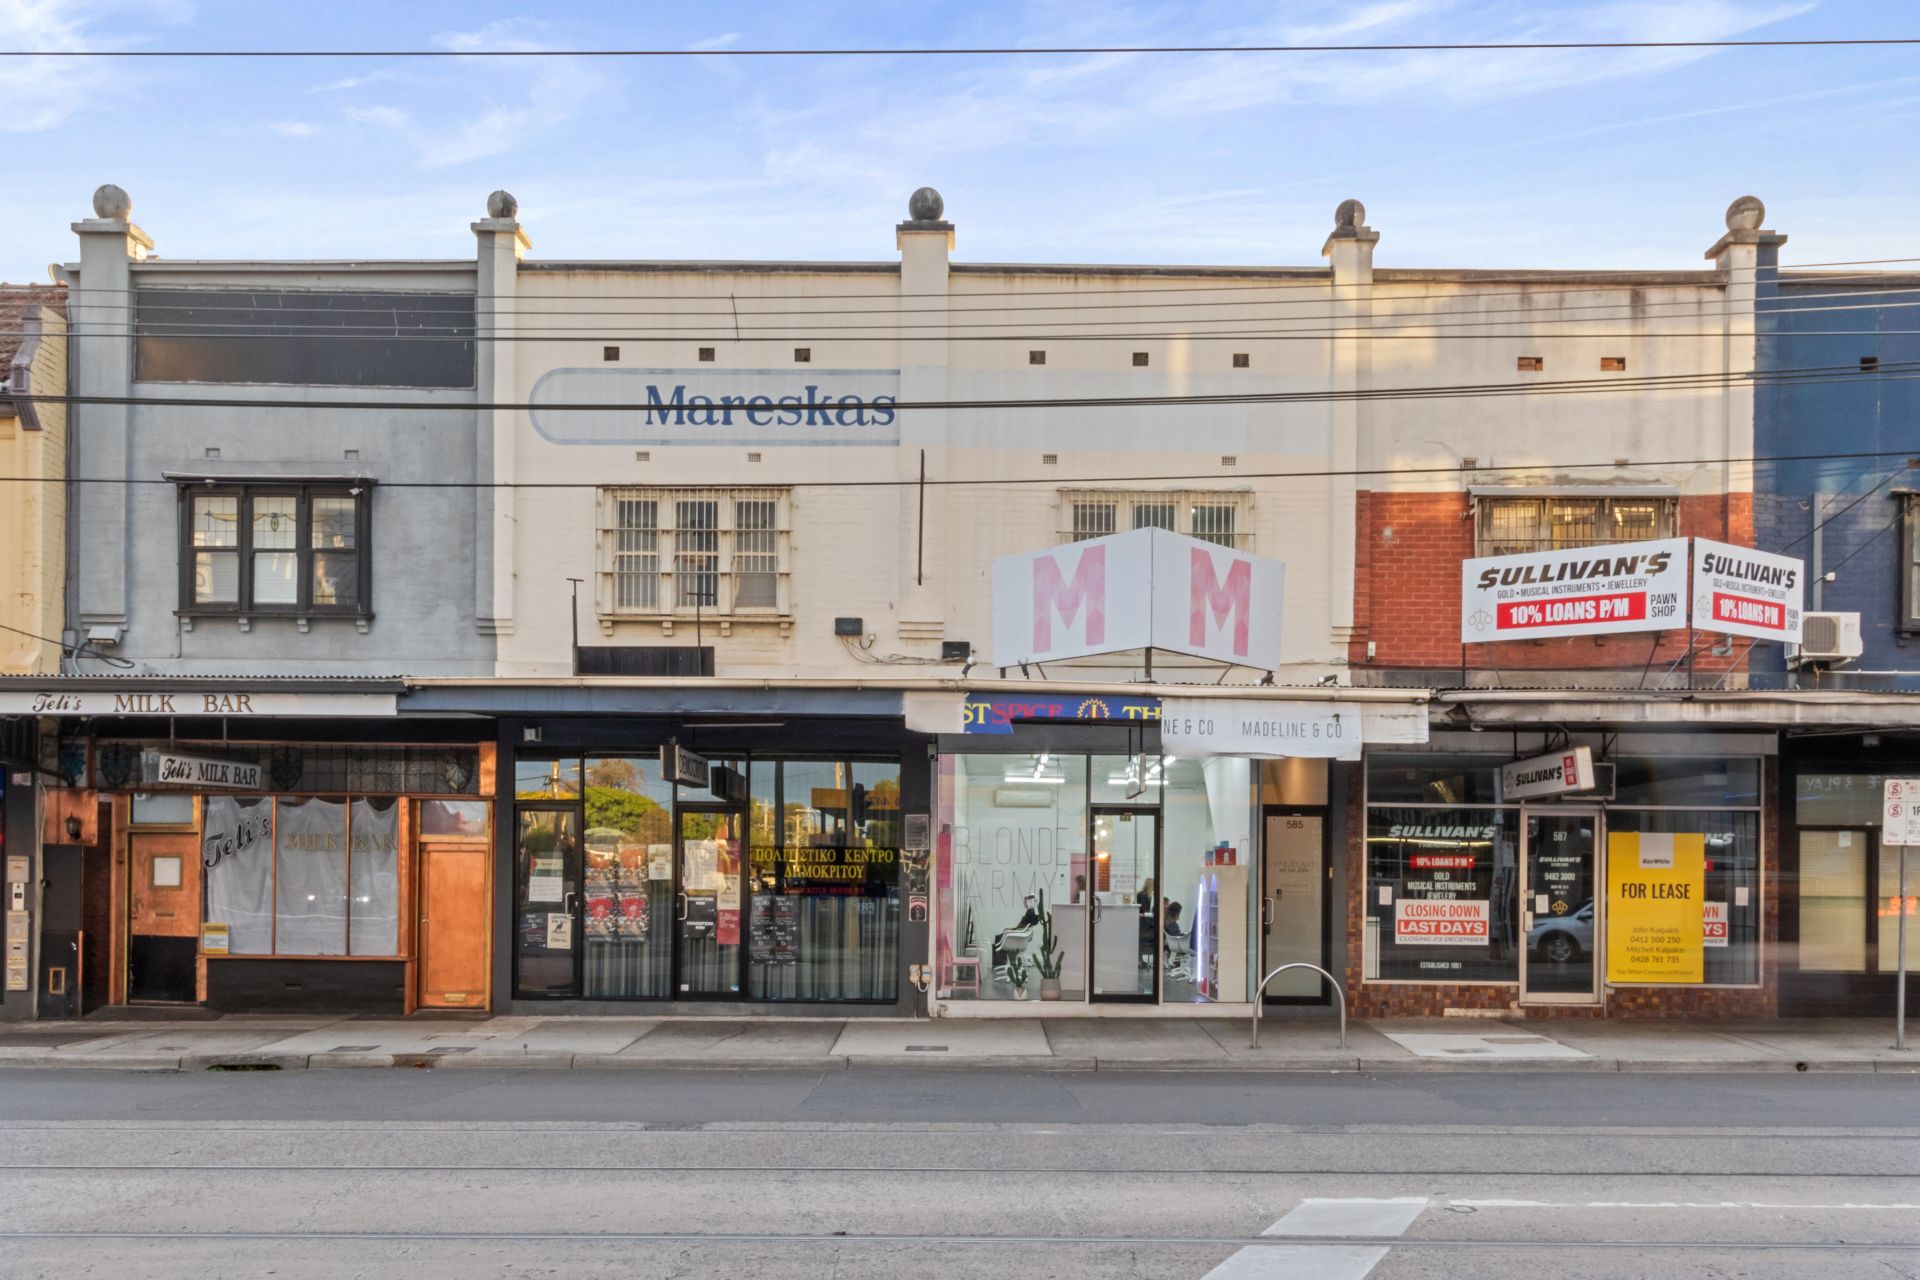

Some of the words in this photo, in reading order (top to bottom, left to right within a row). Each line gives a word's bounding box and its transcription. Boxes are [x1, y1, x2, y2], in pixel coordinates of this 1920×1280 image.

[645, 385, 896, 426] Mareskas
[1497, 590, 1514, 599] GOLD
[1521, 586, 1550, 597] MUSICAL
[1551, 582, 1600, 595] INSTRUMENTS
[1607, 578, 1648, 590] JEWELLERY
[1033, 544, 1105, 654] M
[1189, 546, 1252, 657] M
[1650, 593, 1678, 606] PAWN
[1510, 605, 1542, 625] 10%
[1545, 601, 1596, 622] LOANS
[1600, 598, 1629, 618] P/M
[1651, 605, 1676, 618] SHOP
[1720, 598, 1737, 618] 10%
[1738, 601, 1763, 623] LOANS
[32, 693, 82, 712] Teli's
[114, 694, 176, 713] MILK
[203, 694, 254, 713] BAR
[1184, 719, 1192, 735] &
[1199, 719, 1214, 736] CO
[1242, 721, 1306, 738] MADELINE
[1313, 722, 1320, 738] &
[1327, 722, 1342, 738] CO
[161, 758, 192, 781] Teli's
[197, 762, 229, 784] MILK
[233, 765, 258, 786] BAR
[1286, 820, 1304, 829] 585
[203, 815, 272, 868] Teli's
[952, 826, 1069, 866] BLONDE
[1434, 871, 1450, 881] GOLD
[965, 870, 1056, 909] ARMY
[1407, 881, 1434, 891] MUSICAL
[1434, 881, 1477, 892] INSTRUMENTS
[1621, 882, 1647, 899] FOR
[1652, 882, 1691, 899] LEASE
[1405, 904, 1447, 918] CLOSING
[1449, 904, 1480, 918] DOWN
[1400, 921, 1438, 933] LAST
[1440, 921, 1484, 934] DAYS
